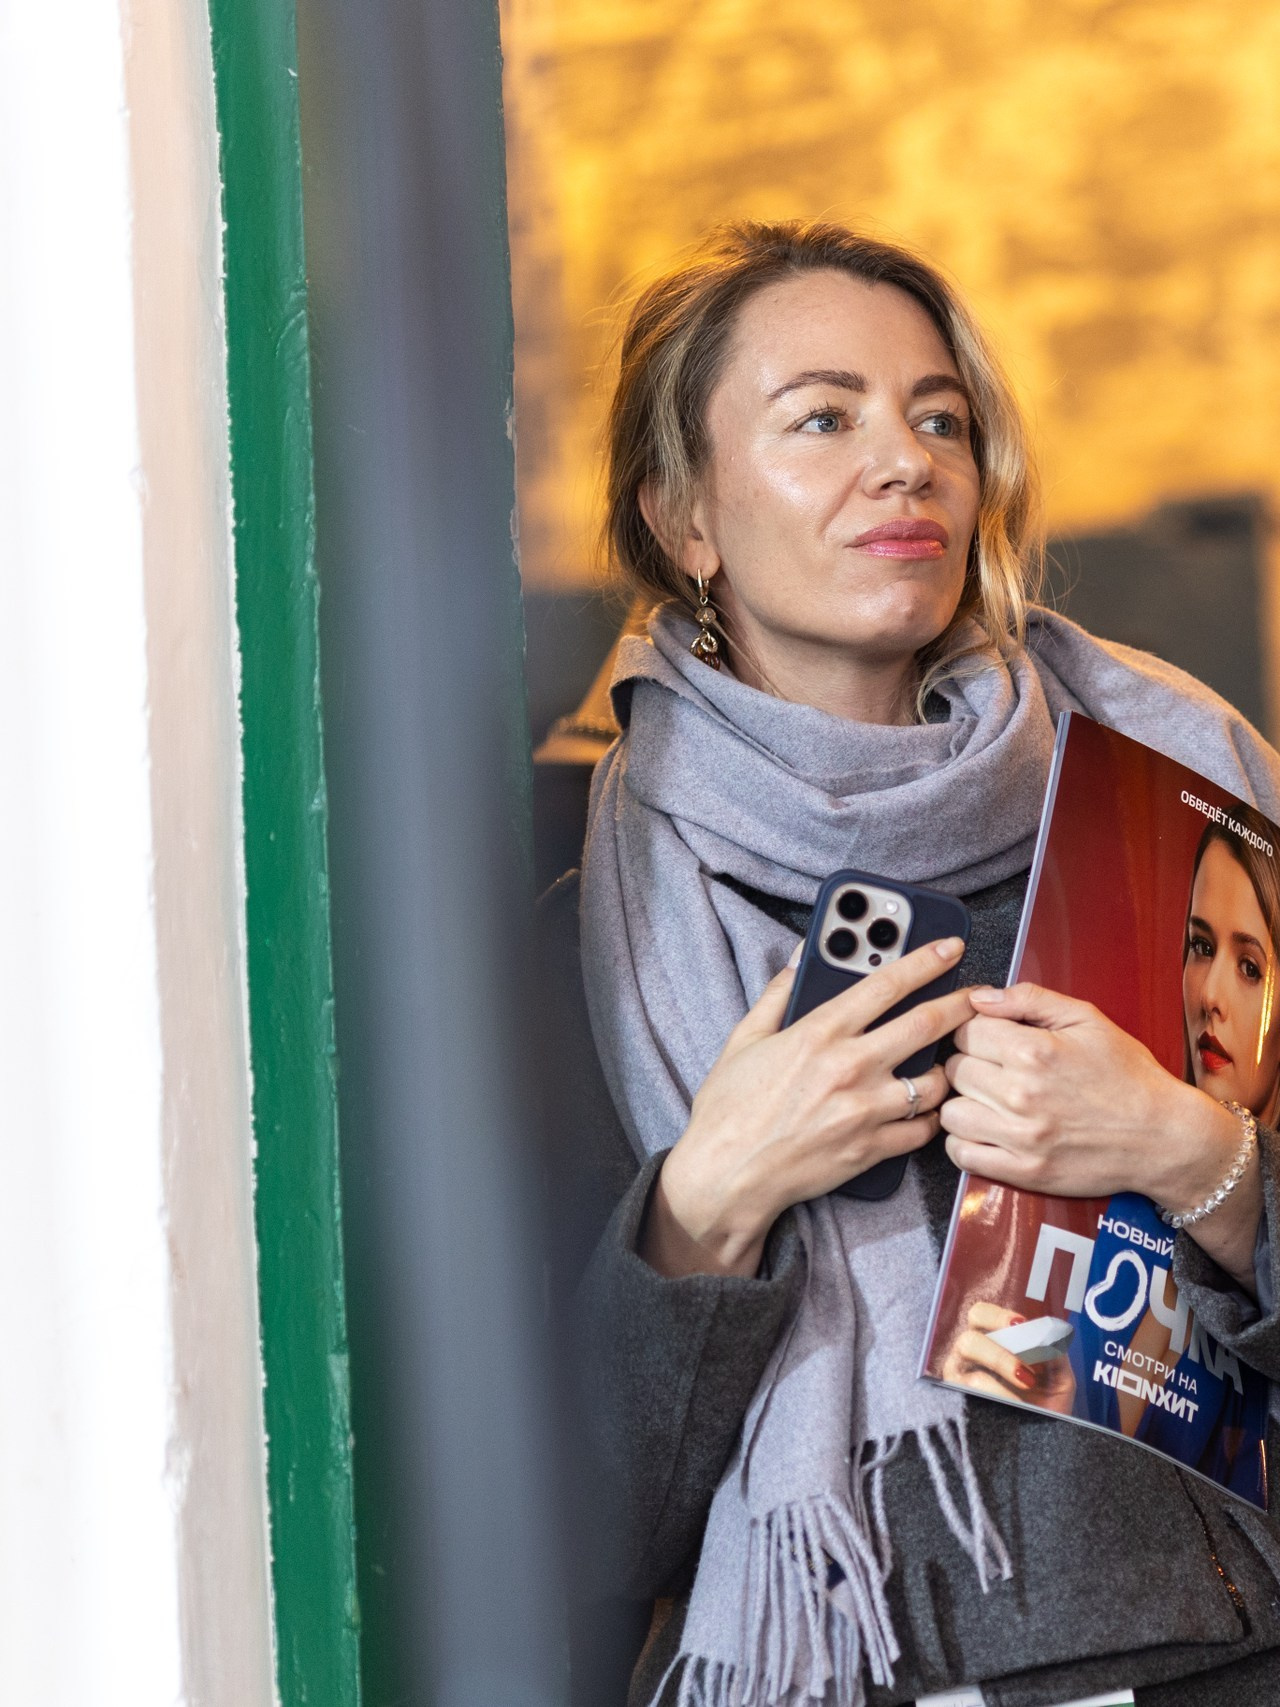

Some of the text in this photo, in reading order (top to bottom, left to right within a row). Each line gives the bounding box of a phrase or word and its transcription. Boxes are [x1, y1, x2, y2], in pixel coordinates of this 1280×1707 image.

[1180, 790, 1274, 857] ОБВЕДЁТ КАЖДОГО
[1097, 1214, 1175, 1261] НОВЫЙ
[1104, 1340, 1198, 1396] СМОТРИ НА
